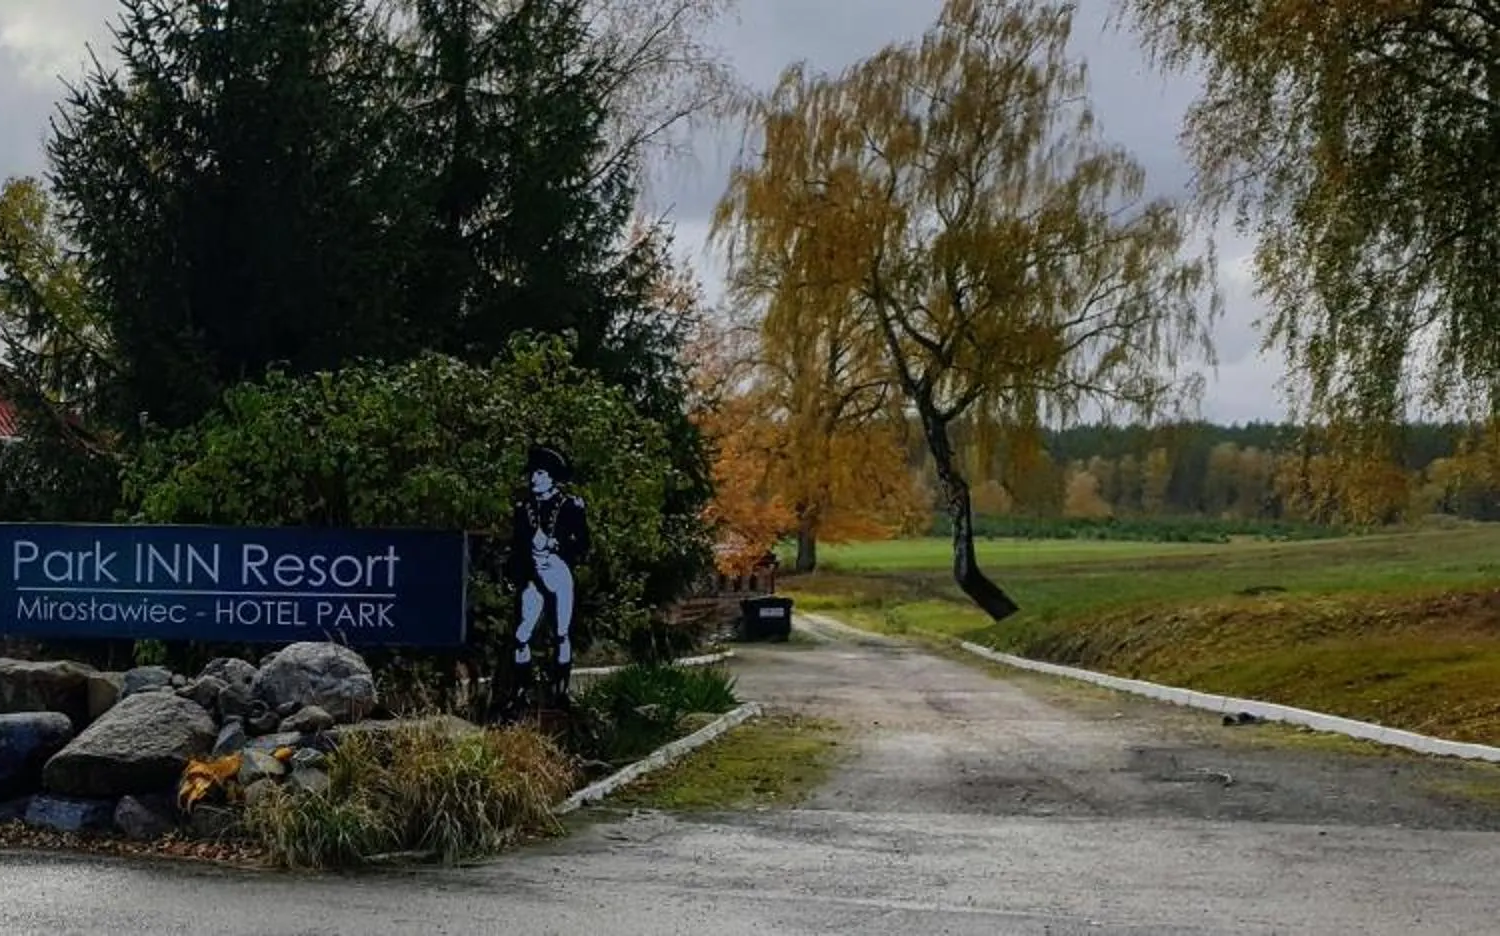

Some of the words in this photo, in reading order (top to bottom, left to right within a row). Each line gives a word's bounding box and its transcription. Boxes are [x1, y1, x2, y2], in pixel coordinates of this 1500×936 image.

[13, 540, 119, 582] Park
[135, 543, 219, 584] INN
[242, 543, 400, 587] Resort
[17, 596, 187, 623] Mirosławiec
[215, 599, 307, 625] HOTEL
[317, 602, 395, 627] PARK
